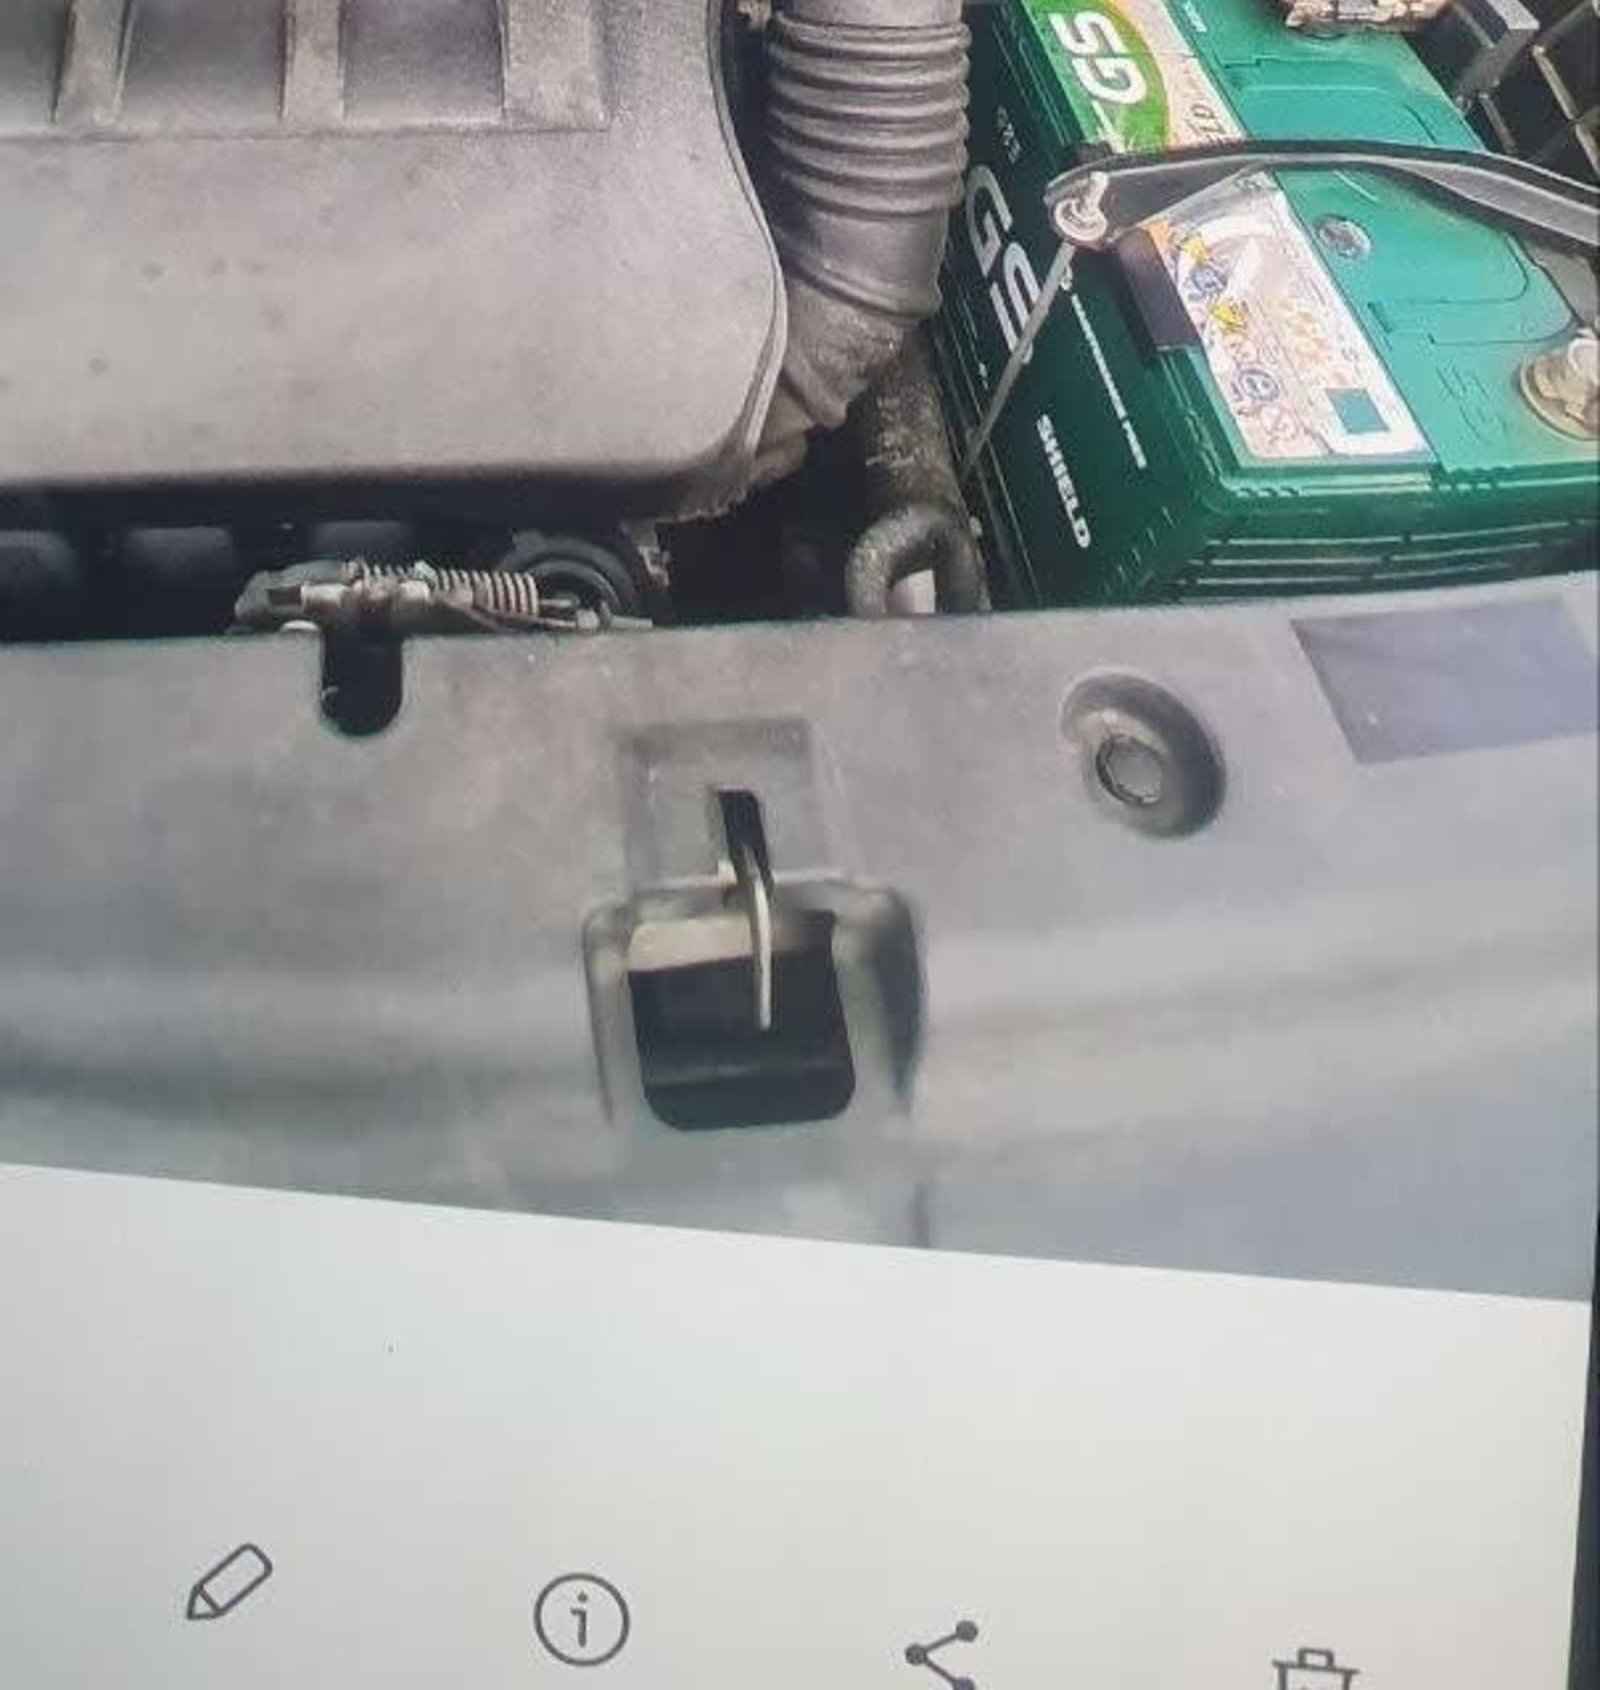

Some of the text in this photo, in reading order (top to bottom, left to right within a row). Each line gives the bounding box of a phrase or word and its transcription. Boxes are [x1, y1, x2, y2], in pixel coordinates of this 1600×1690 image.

[1047, 10, 1148, 105] GS
[965, 164, 1042, 364] GS
[1037, 413, 1092, 549] SHIELD
